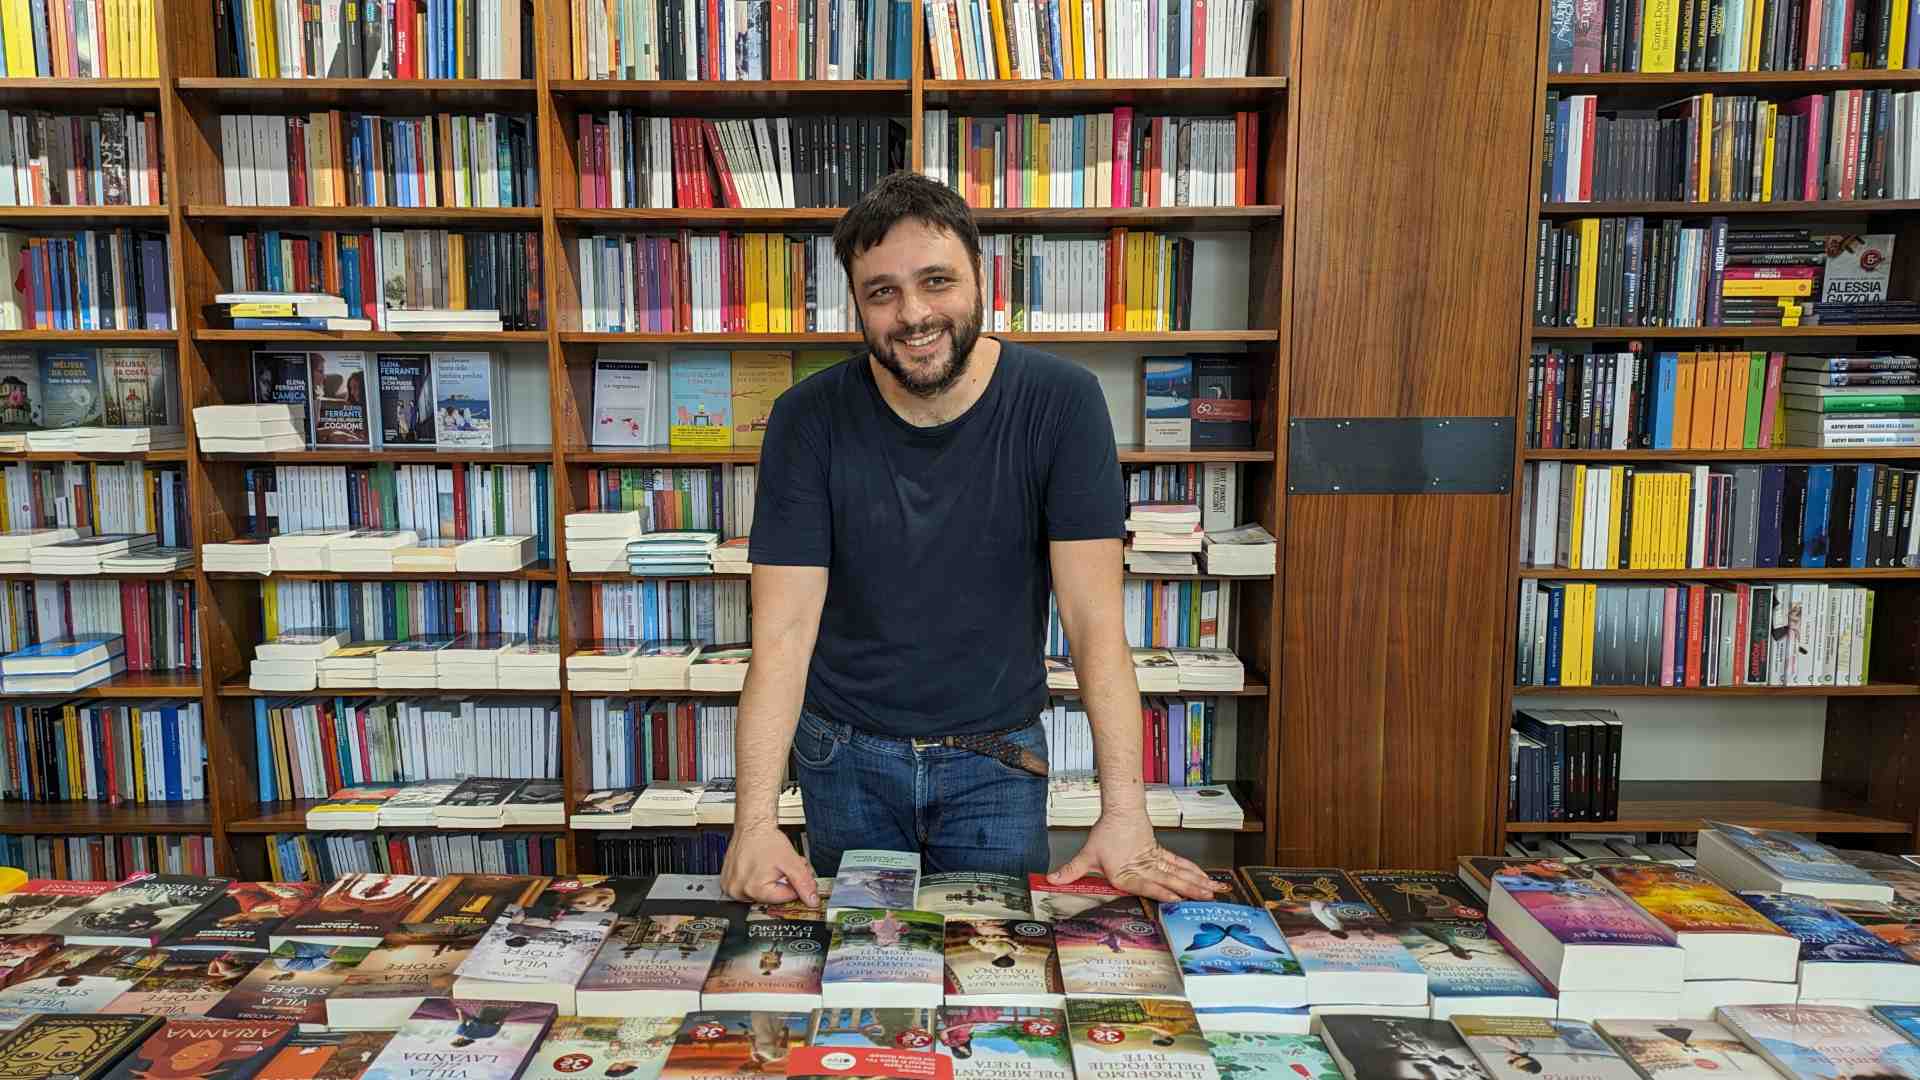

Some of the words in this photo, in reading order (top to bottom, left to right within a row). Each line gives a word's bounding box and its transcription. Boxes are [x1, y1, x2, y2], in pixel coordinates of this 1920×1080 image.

[1715, 246, 1725, 271] COBEN
[1828, 281, 1881, 294] ALESSIA
[1826, 294, 1881, 305] GAZZOLA
[380, 367, 420, 375] FERRANTE
[272, 391, 306, 400] L'AMICA
[324, 422, 363, 430] COGNOME
[1180, 907, 1248, 917] FARFALLE
[747, 930, 813, 938] LETTERA
[501, 948, 564, 958] STOFFE
[382, 962, 449, 970] STOFFE
[503, 959, 548, 968] VILLA
[384, 974, 429, 984] VILLA
[24, 986, 91, 997] STOFFE
[262, 984, 329, 996] STOFFE
[146, 993, 210, 1003] STOFFE
[261, 996, 308, 1007] VILLA
[16, 998, 66, 1010] VILLA
[138, 1006, 187, 1016] VILLA
[166, 1028, 280, 1039] ARIANNA
[403, 1052, 499, 1064] LAVANDA
[975, 1061, 1014, 1070] SETA
[1017, 1061, 1032, 1070] DI
[1088, 1063, 1156, 1071] FOGLIE
[1158, 1063, 1206, 1071] DELLE
[410, 1068, 469, 1079] VILLA
[954, 1070, 1031, 1079] MERCANT
[1033, 1071, 1066, 1079] DEL
[1096, 1071, 1184, 1079] PROFUMO
[1188, 1071, 1202, 1079] IL
